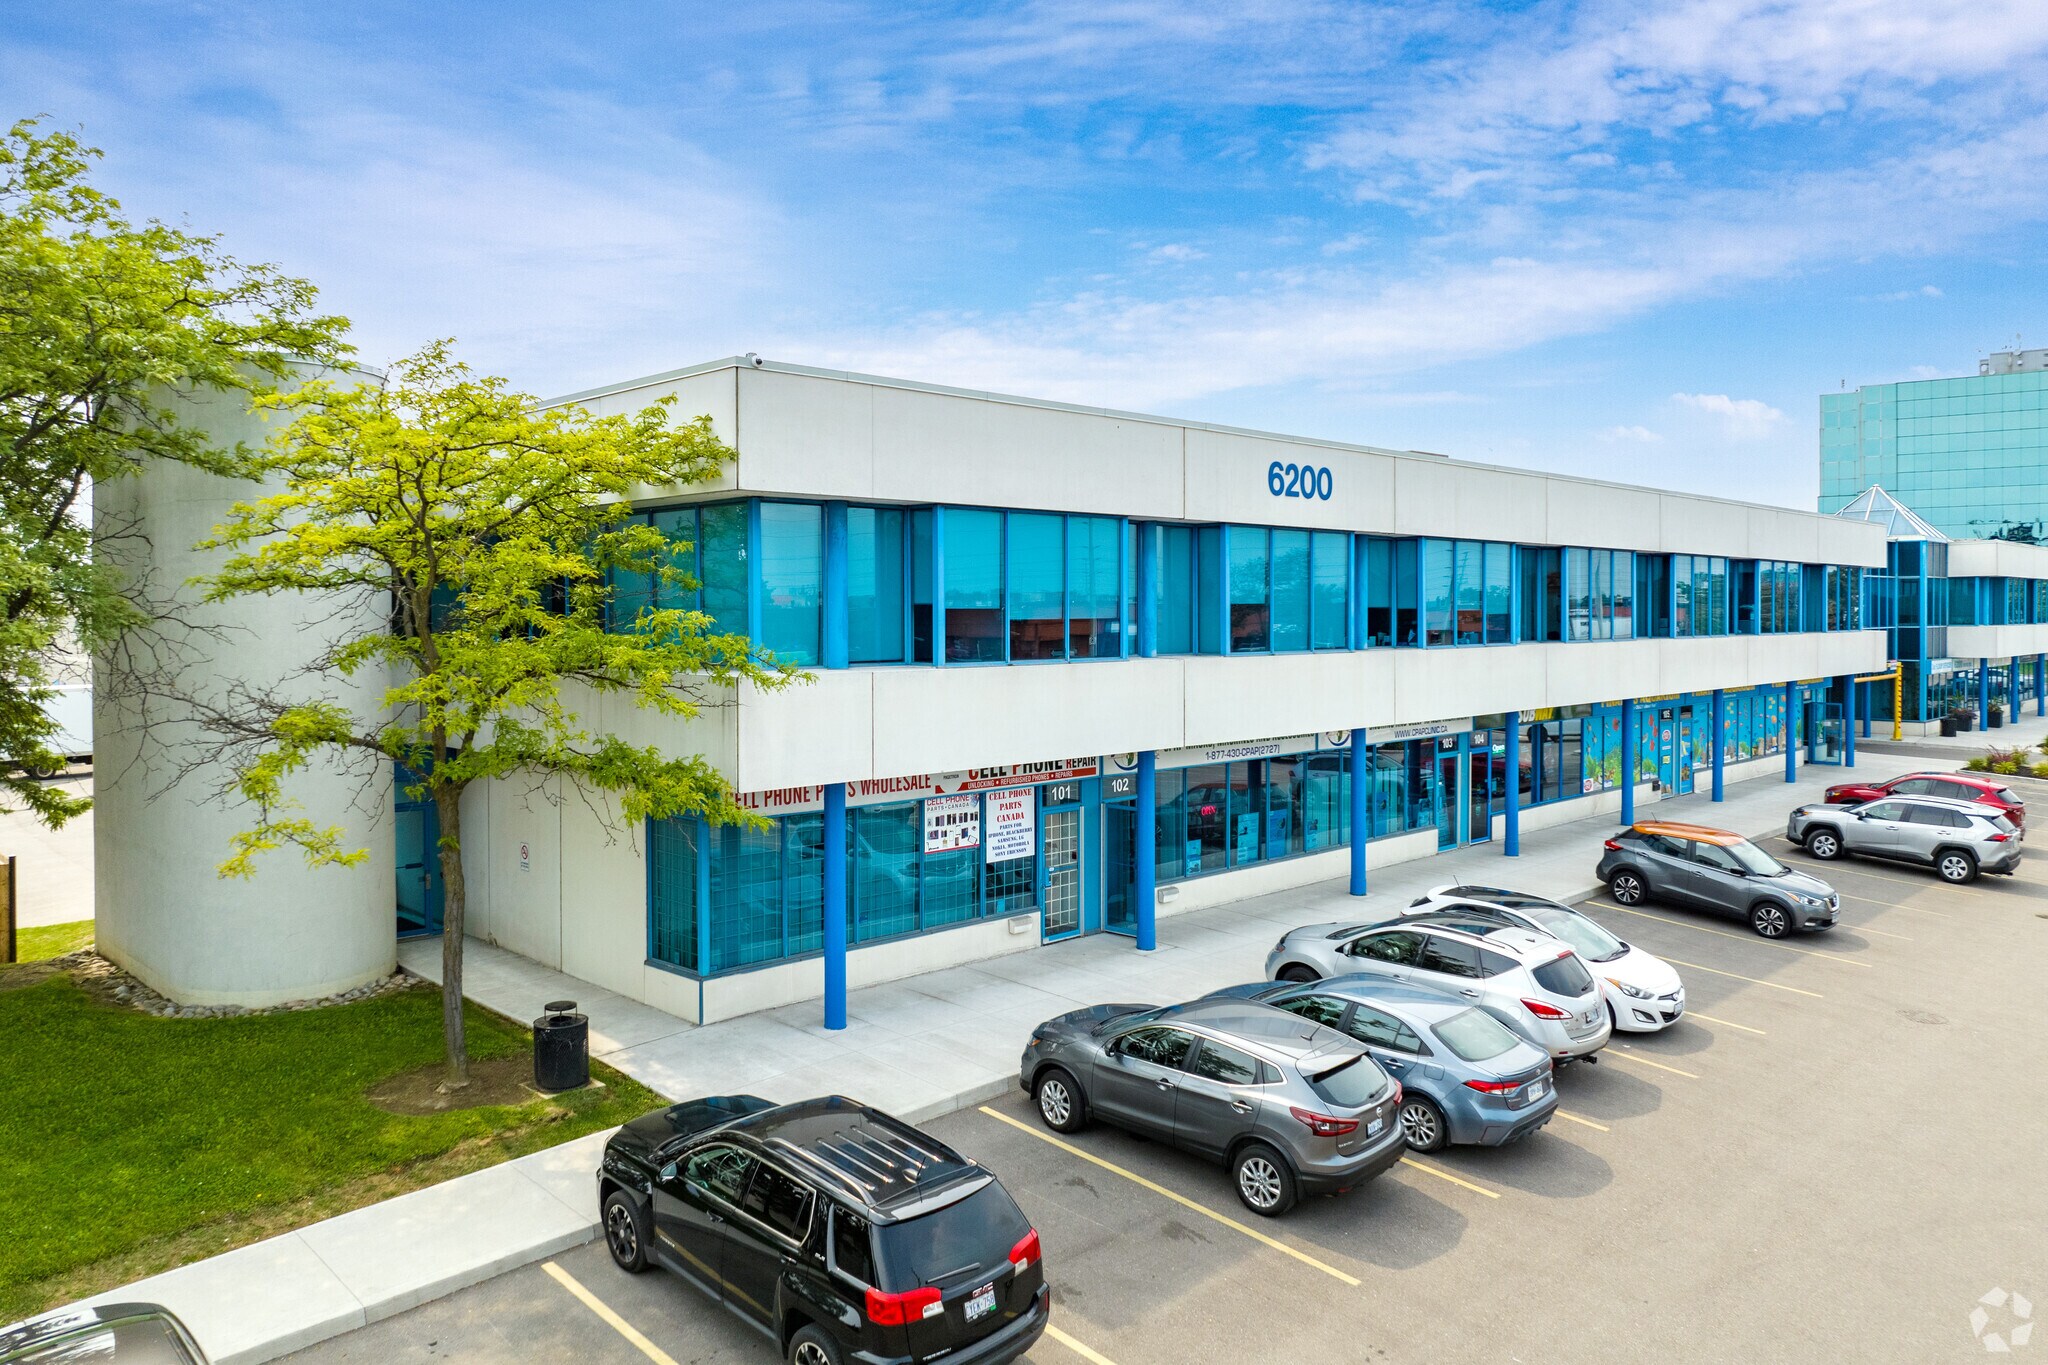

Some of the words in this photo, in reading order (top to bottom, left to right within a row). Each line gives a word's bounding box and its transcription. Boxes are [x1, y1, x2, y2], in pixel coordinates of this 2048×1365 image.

[1268, 461, 1333, 501] 6200
[1442, 738, 1453, 748] 103
[1474, 734, 1485, 744] 104
[967, 780, 995, 789] UNLOCKING
[1000, 775, 1031, 786] REFURBISHED
[1032, 773, 1050, 782] PHONES
[1111, 778, 1129, 793] 102
[733, 792, 760, 810] ELL
[764, 786, 811, 808] PHONE
[860, 774, 932, 796] WHOLESALE
[989, 791, 1006, 801] CELL
[1008, 788, 1032, 799] PHONE
[1051, 785, 1071, 801] 101
[926, 797, 943, 806] CELL
[945, 795, 970, 804] PHONE
[999, 801, 1022, 811] PARTS
[1201, 805, 1217, 816] OPEN
[996, 812, 1025, 823] CANADA
